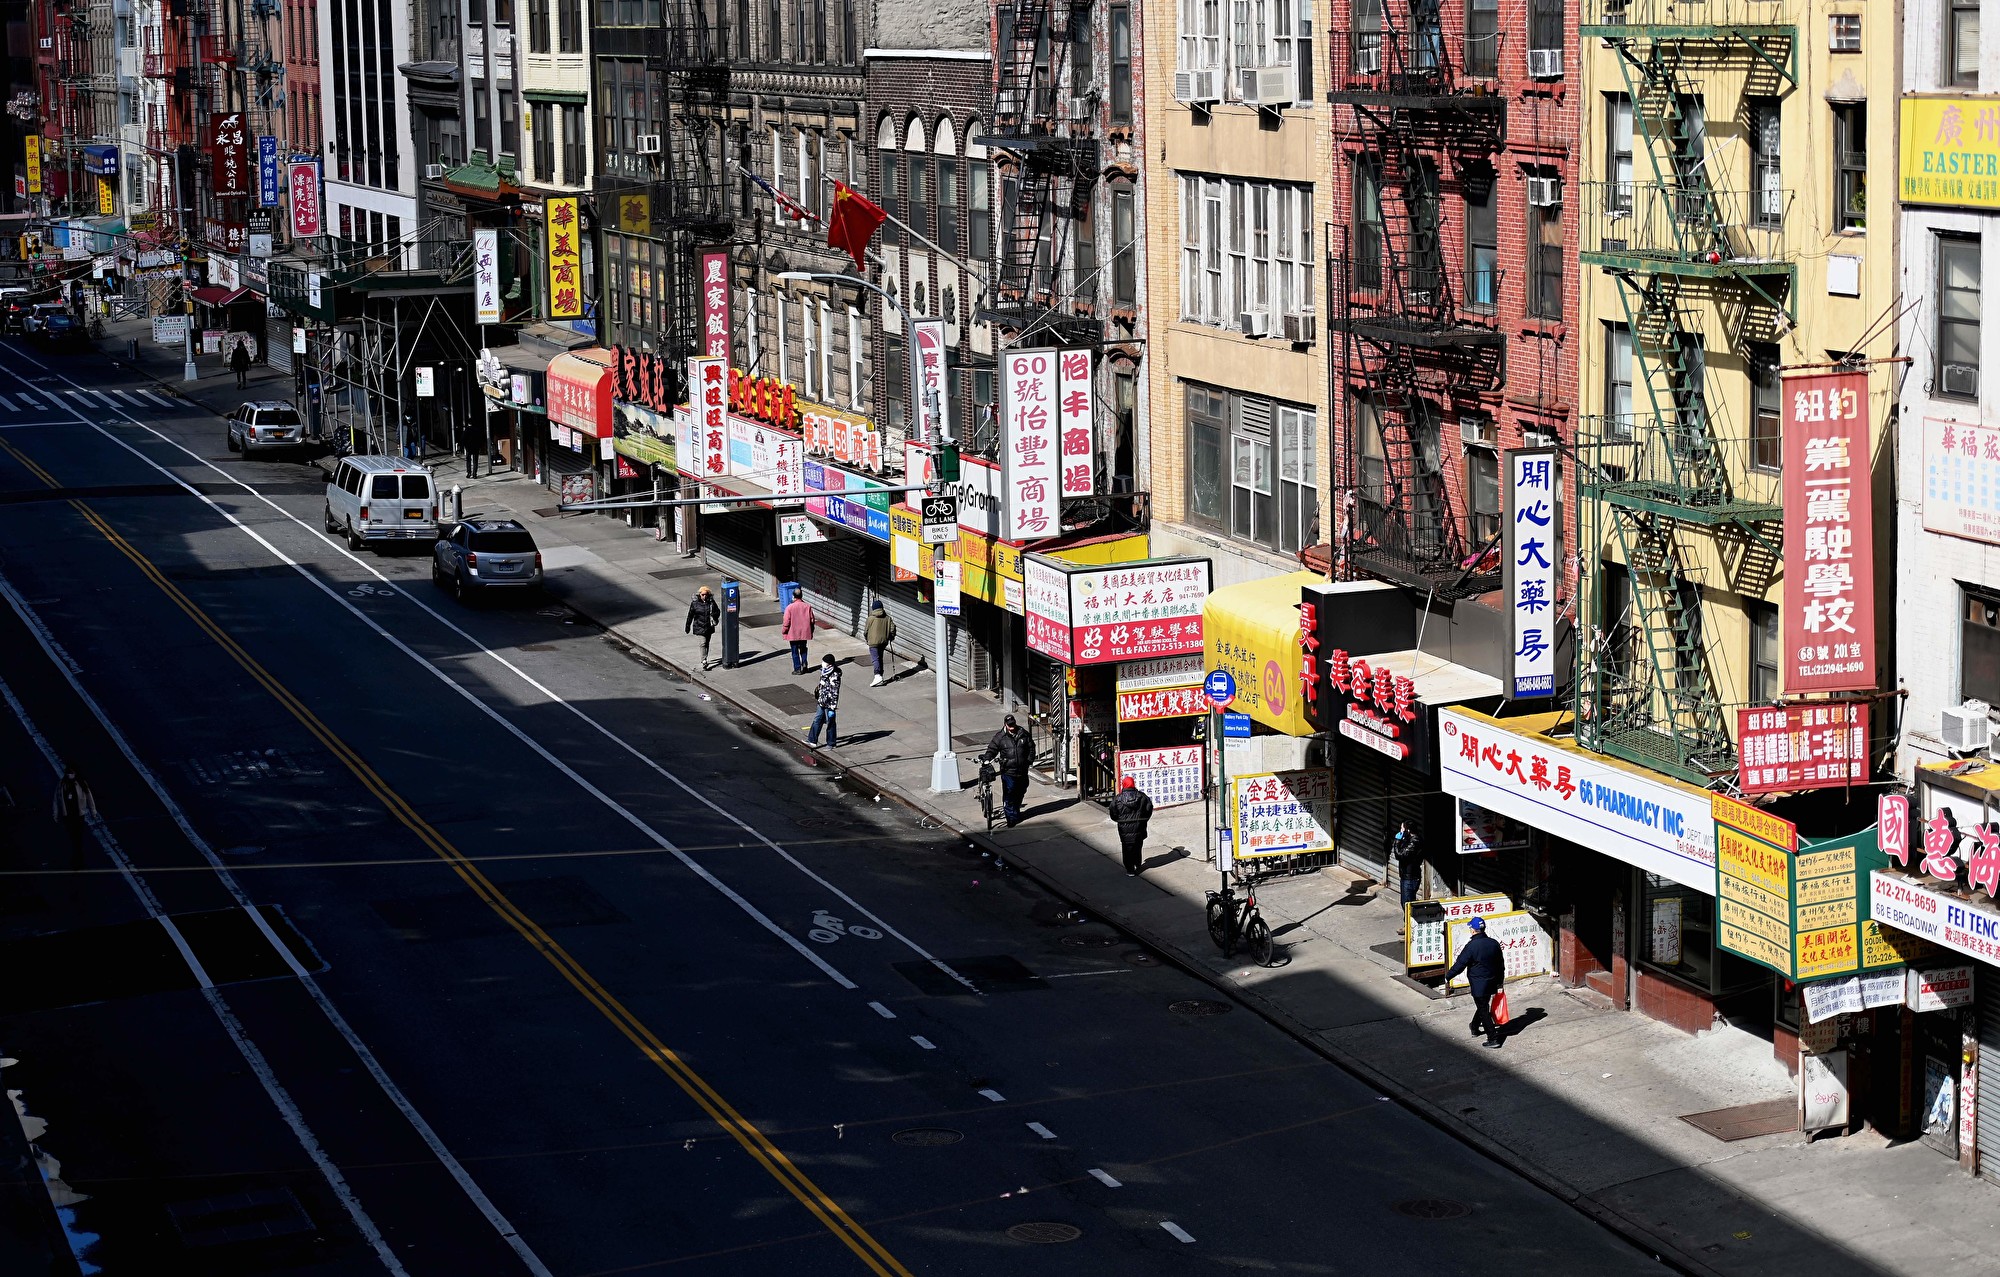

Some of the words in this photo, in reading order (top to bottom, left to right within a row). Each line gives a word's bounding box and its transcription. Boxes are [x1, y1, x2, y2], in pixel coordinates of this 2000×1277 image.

[216, 130, 243, 145] 永昌
[1923, 152, 1998, 176] EASTER
[294, 174, 307, 226] 漂亮人生
[551, 202, 578, 313] 華美商場
[480, 254, 493, 306] 西餅屋
[704, 364, 725, 474] 興旺旺商場
[1794, 388, 1858, 423] 紐約
[1803, 437, 1856, 634] 第一駕駛學校
[1515, 460, 1551, 663] 開心大藥房
[1084, 587, 1174, 609] 福州大花店
[1084, 621, 1201, 647] 好好駕駛學校
[1134, 645, 1150, 654] FAX:
[1152, 640, 1204, 652] 212-513-1380
[1265, 667, 1284, 707] 64
[1123, 749, 1199, 768] 福州大花店
[1460, 733, 1576, 801] 開心大藥房
[1580, 778, 1594, 806] 66
[1596, 784, 1660, 829] PHARMACY
[1663, 807, 1684, 838] INC
[1250, 831, 1314, 848] 郵寄全中國
[1876, 878, 1937, 914] 212-274-8659
[1876, 902, 1884, 916] 68
[1886, 907, 1891, 918] E
[1894, 911, 1938, 937] BROADWAY
[1948, 905, 1964, 928] FEI
[1418, 953, 1434, 962] Tel:
